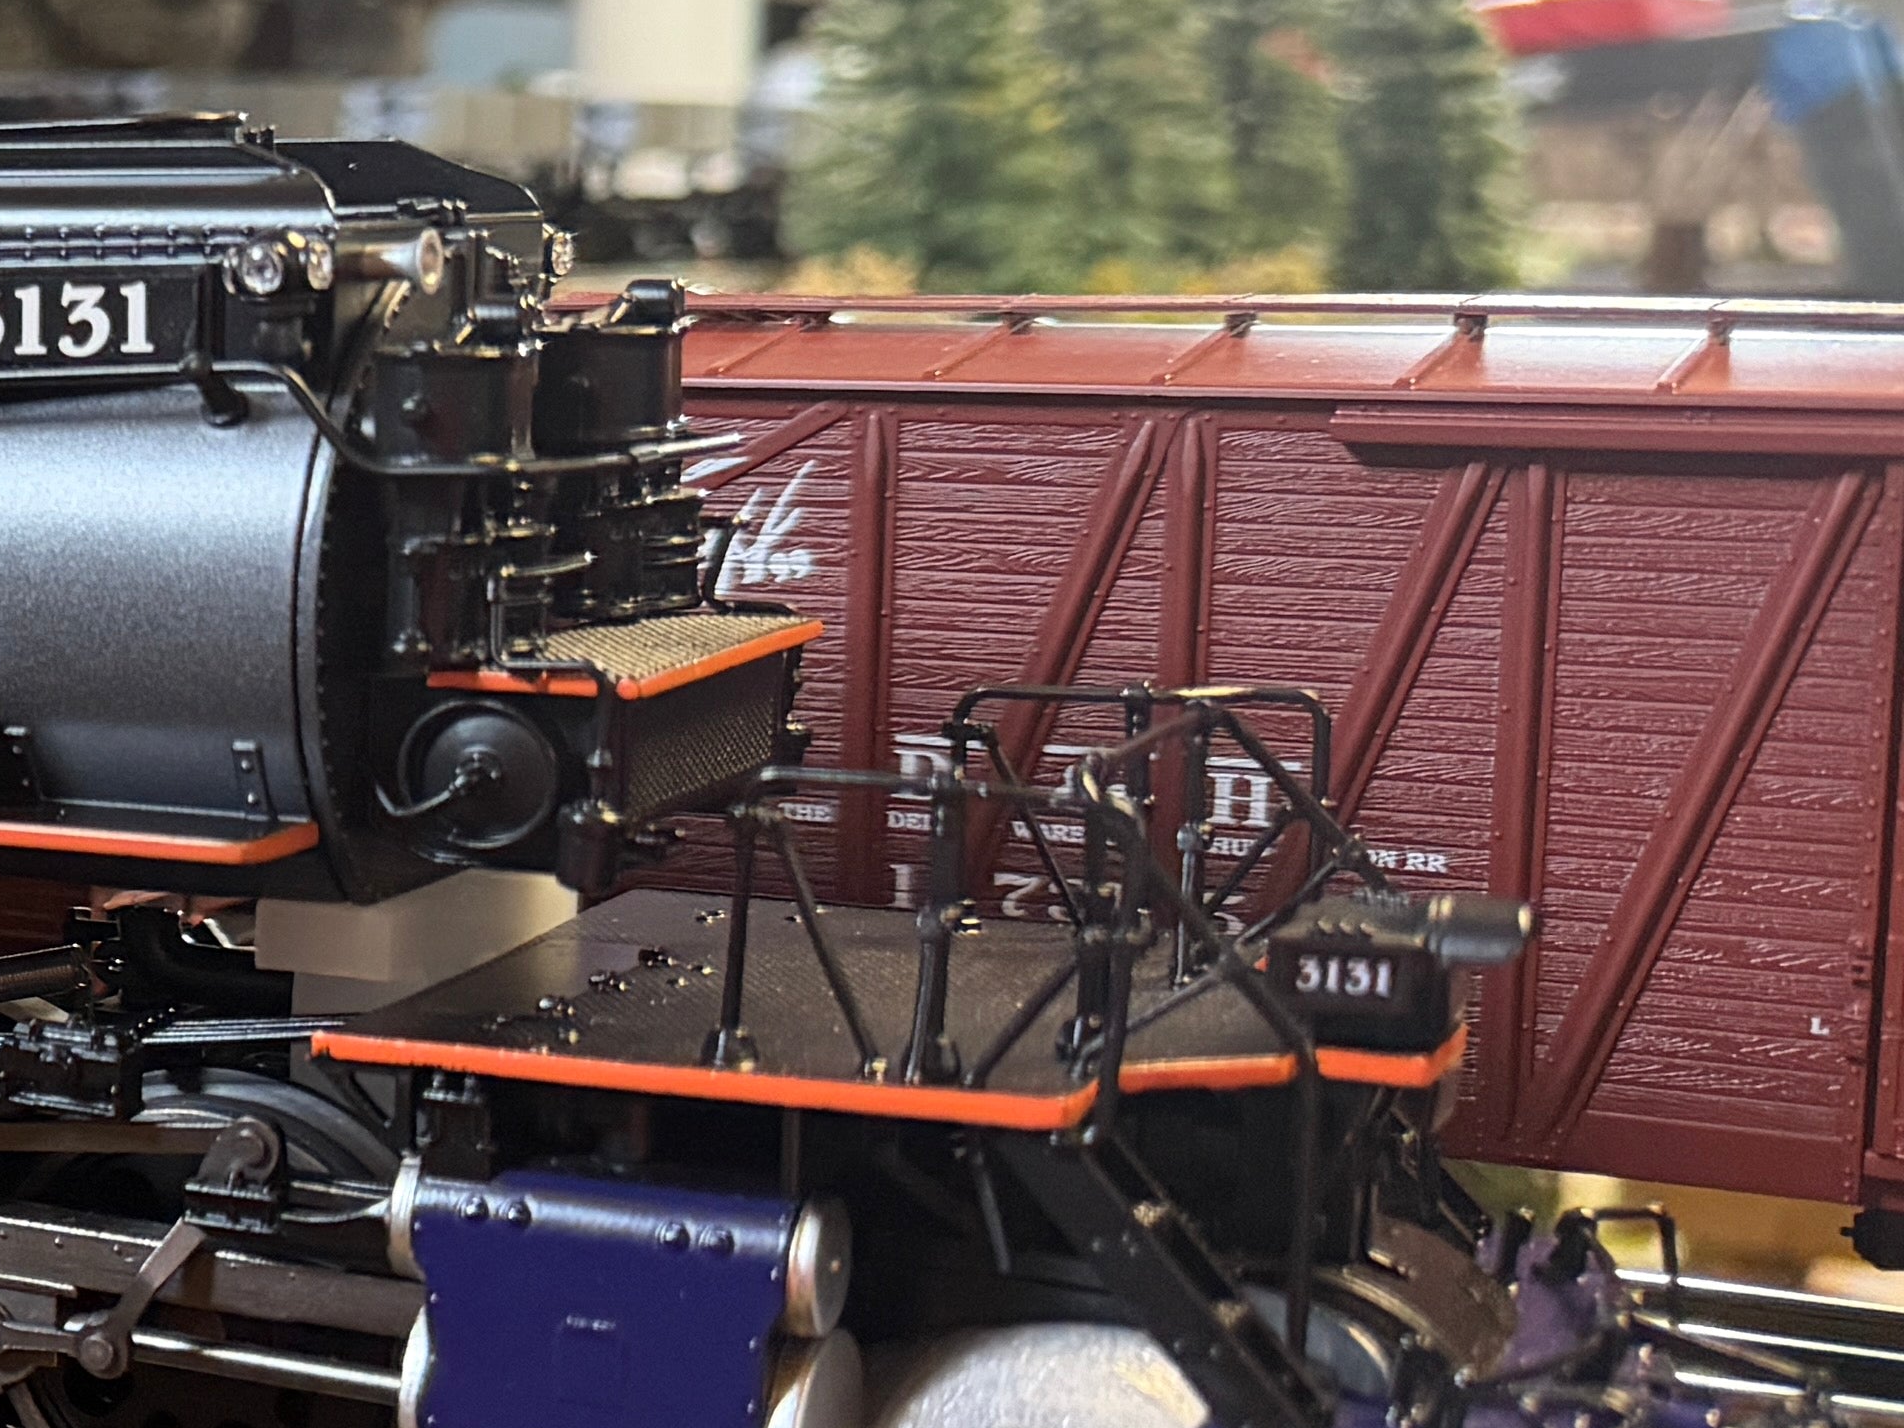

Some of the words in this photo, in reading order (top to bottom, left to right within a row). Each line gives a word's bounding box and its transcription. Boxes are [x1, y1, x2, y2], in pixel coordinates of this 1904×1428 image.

[1204, 772, 1274, 828] H
[777, 801, 834, 824] THE
[1404, 852, 1448, 873] RR
[1295, 954, 1392, 999] 3131
